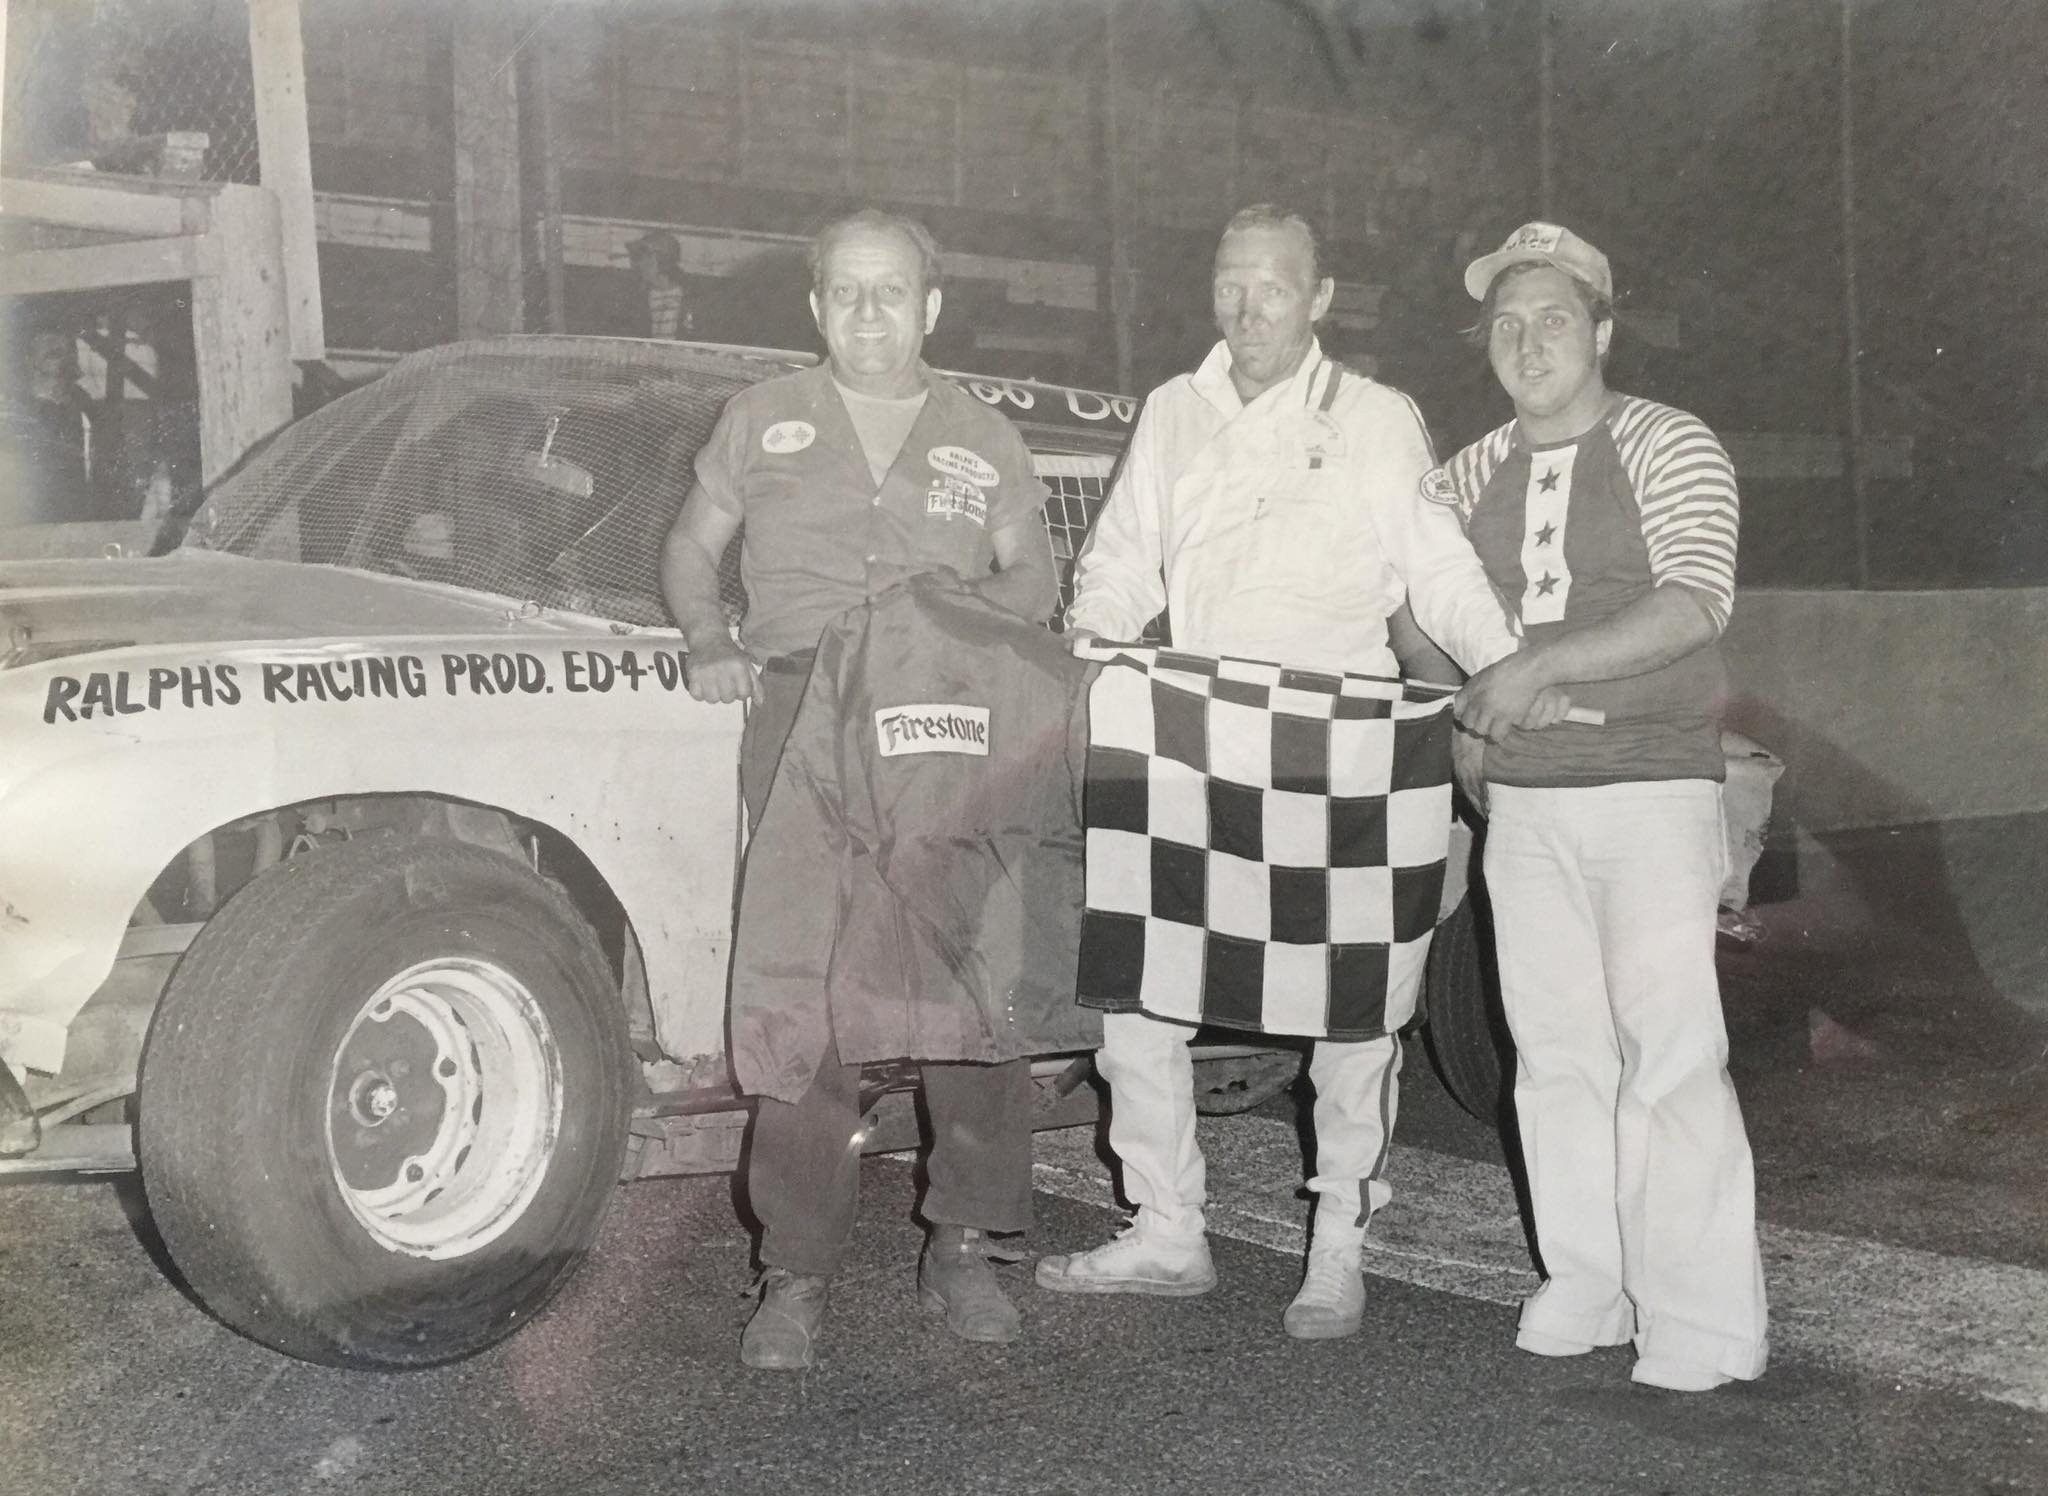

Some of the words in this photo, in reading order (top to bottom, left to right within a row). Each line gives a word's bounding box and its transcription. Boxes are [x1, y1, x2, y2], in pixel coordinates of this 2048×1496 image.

[262, 655, 428, 703] RACING
[441, 653, 554, 696] PROD.
[881, 712, 985, 752] Firestone
